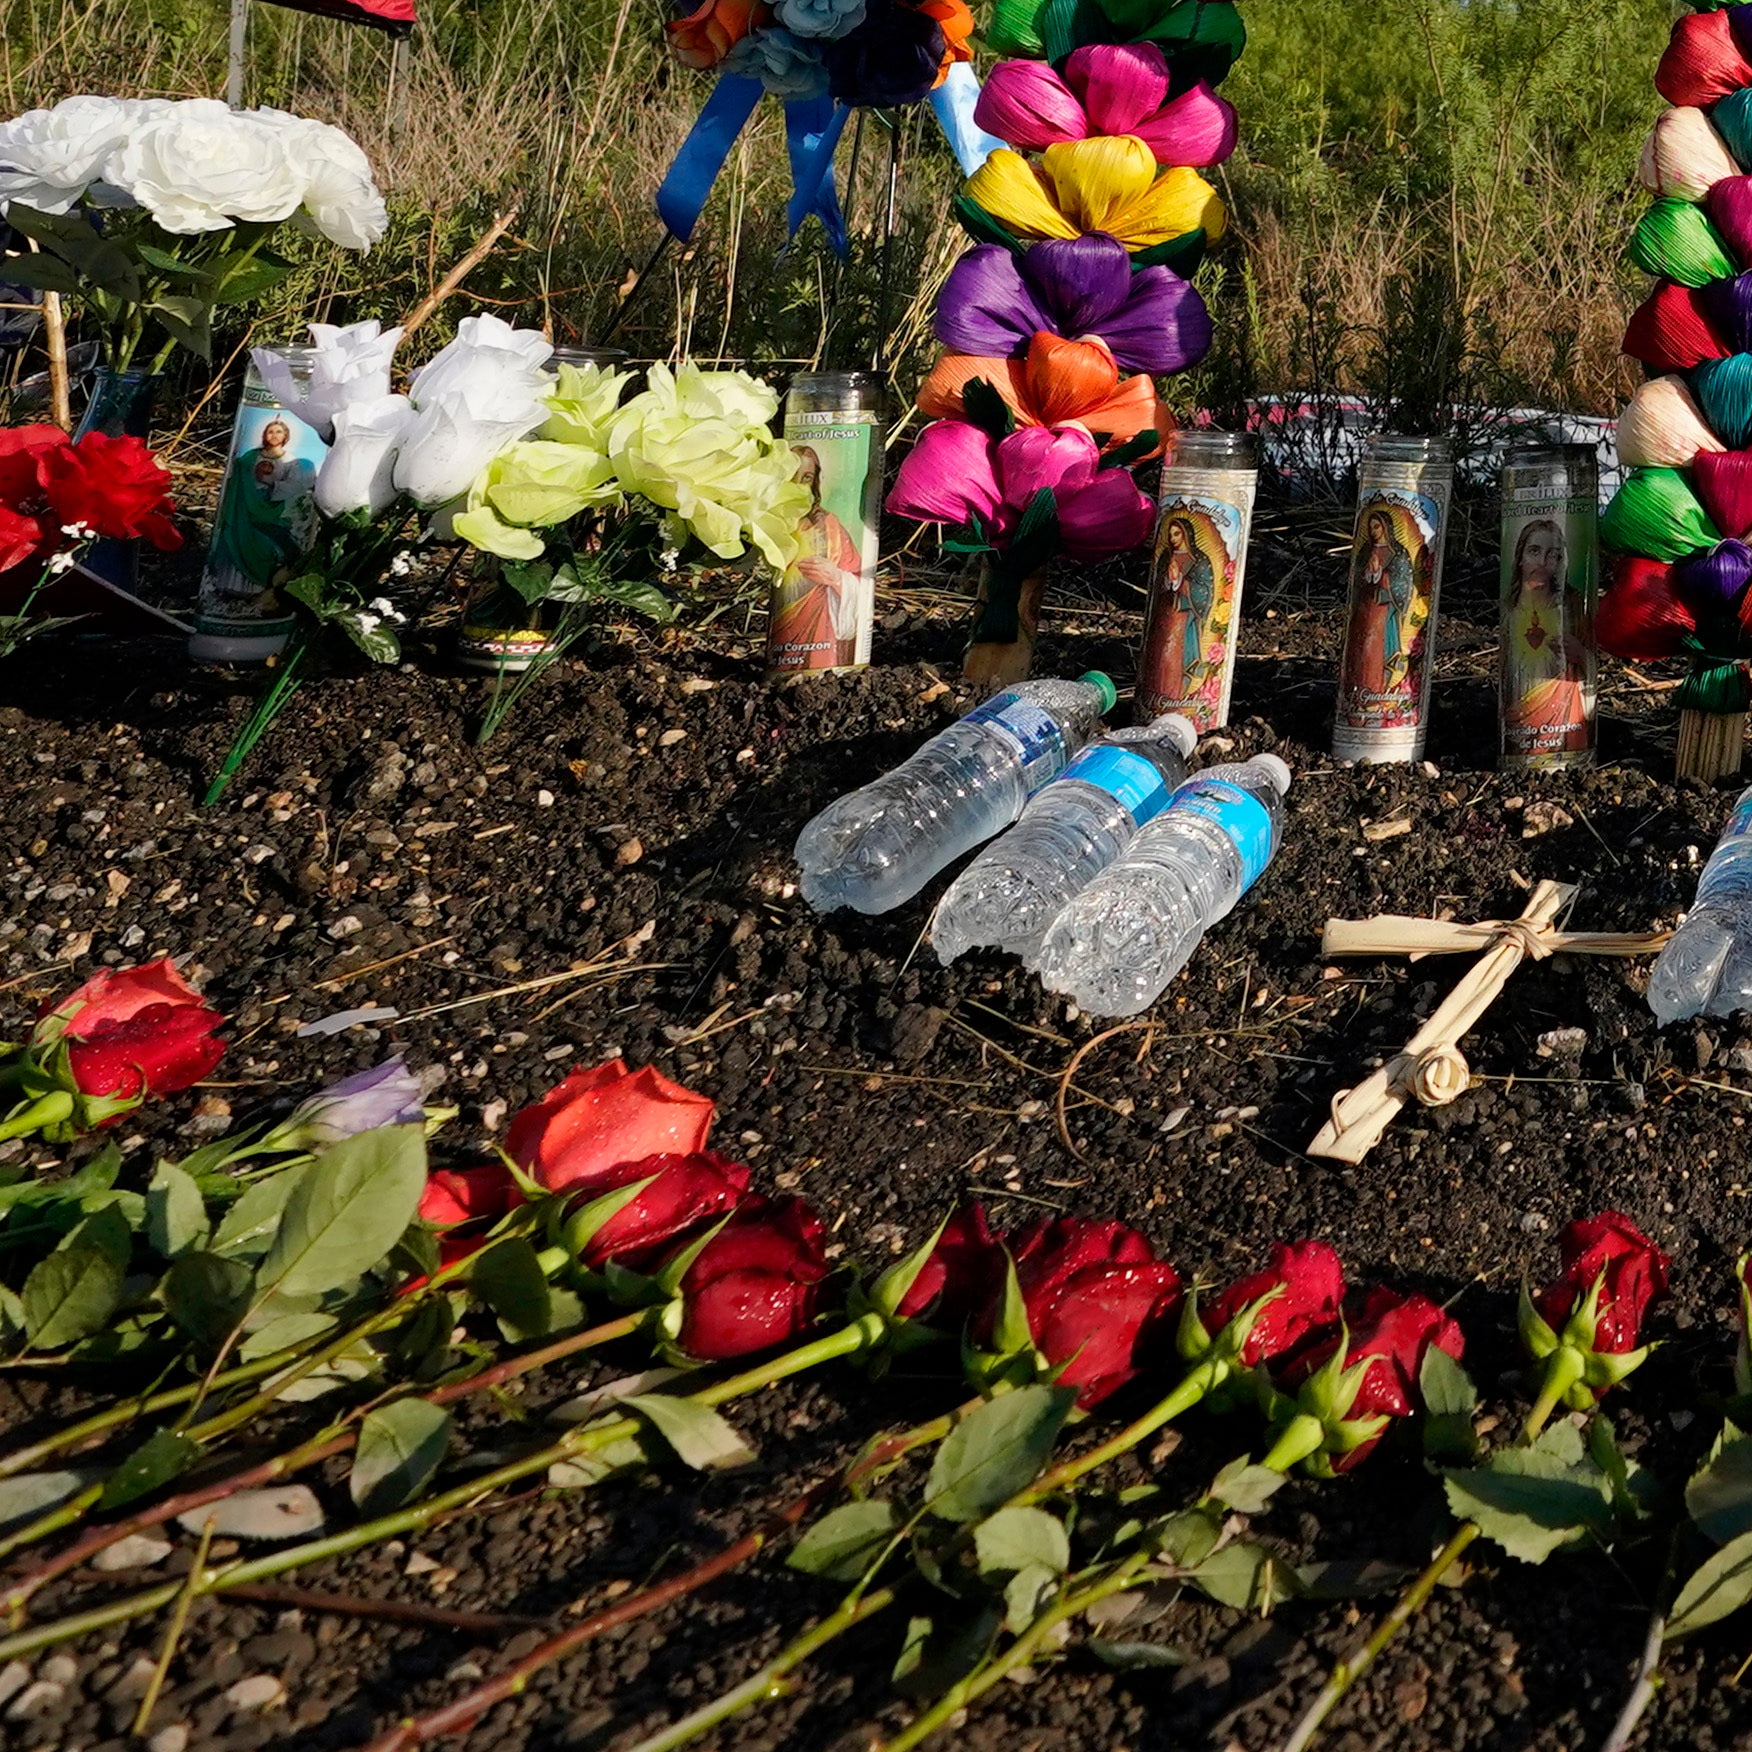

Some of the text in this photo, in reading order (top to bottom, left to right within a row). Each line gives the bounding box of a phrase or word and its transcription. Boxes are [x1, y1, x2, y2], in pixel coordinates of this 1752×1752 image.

[828, 428, 860, 440] Jesus
[784, 640, 832, 652] Corazon
[777, 655, 805, 666] Jesus
[1539, 722, 1583, 735] Corazon
[1532, 737, 1563, 749] Jesus
